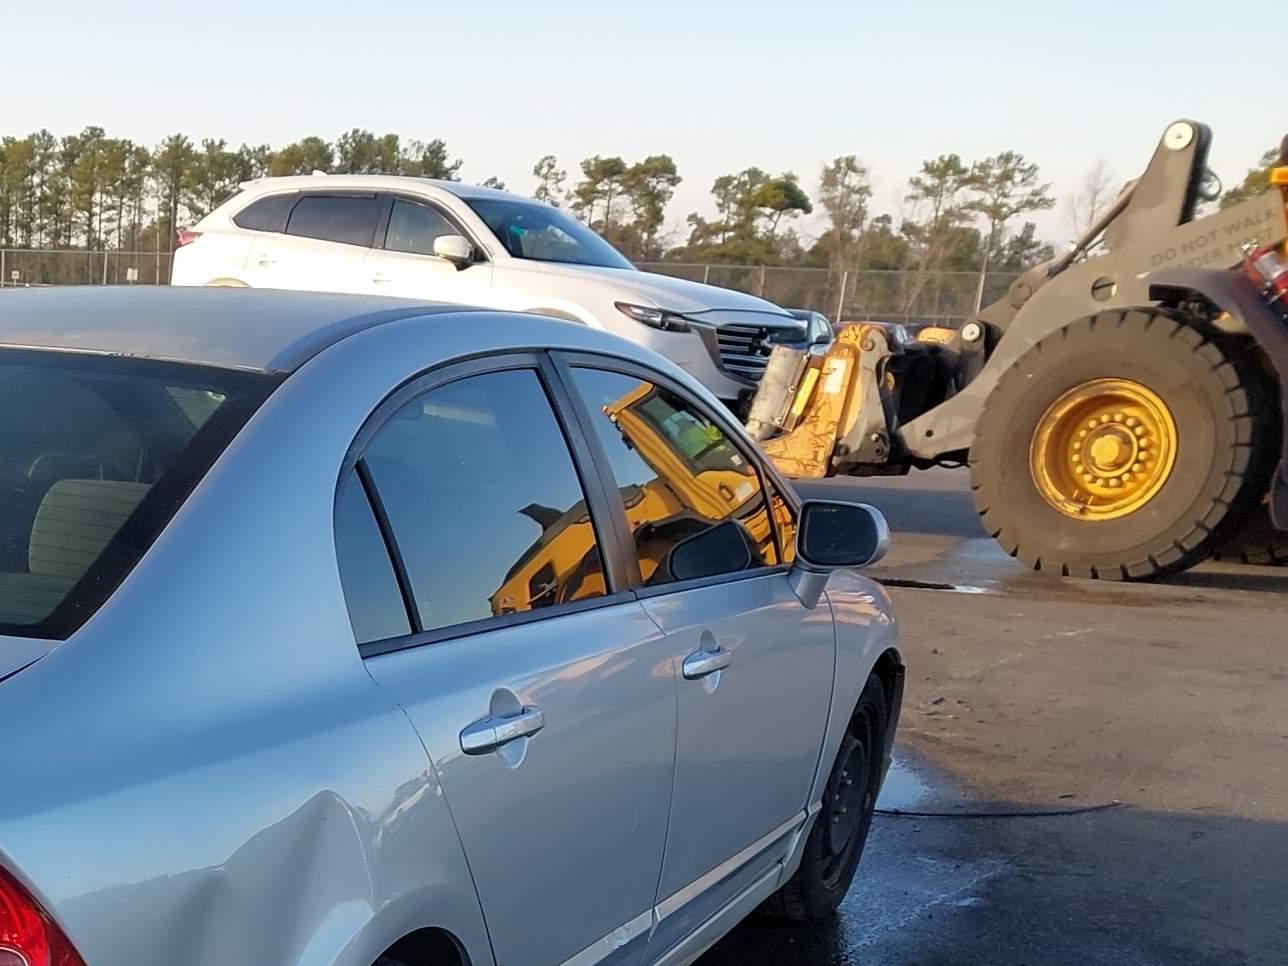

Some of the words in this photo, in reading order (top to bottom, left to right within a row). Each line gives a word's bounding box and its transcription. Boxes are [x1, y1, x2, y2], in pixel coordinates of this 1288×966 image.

[1151, 248, 1177, 266] DO
[1182, 230, 1220, 253] NOT
[1223, 208, 1277, 234] WALK
[1227, 227, 1273, 255] MT
